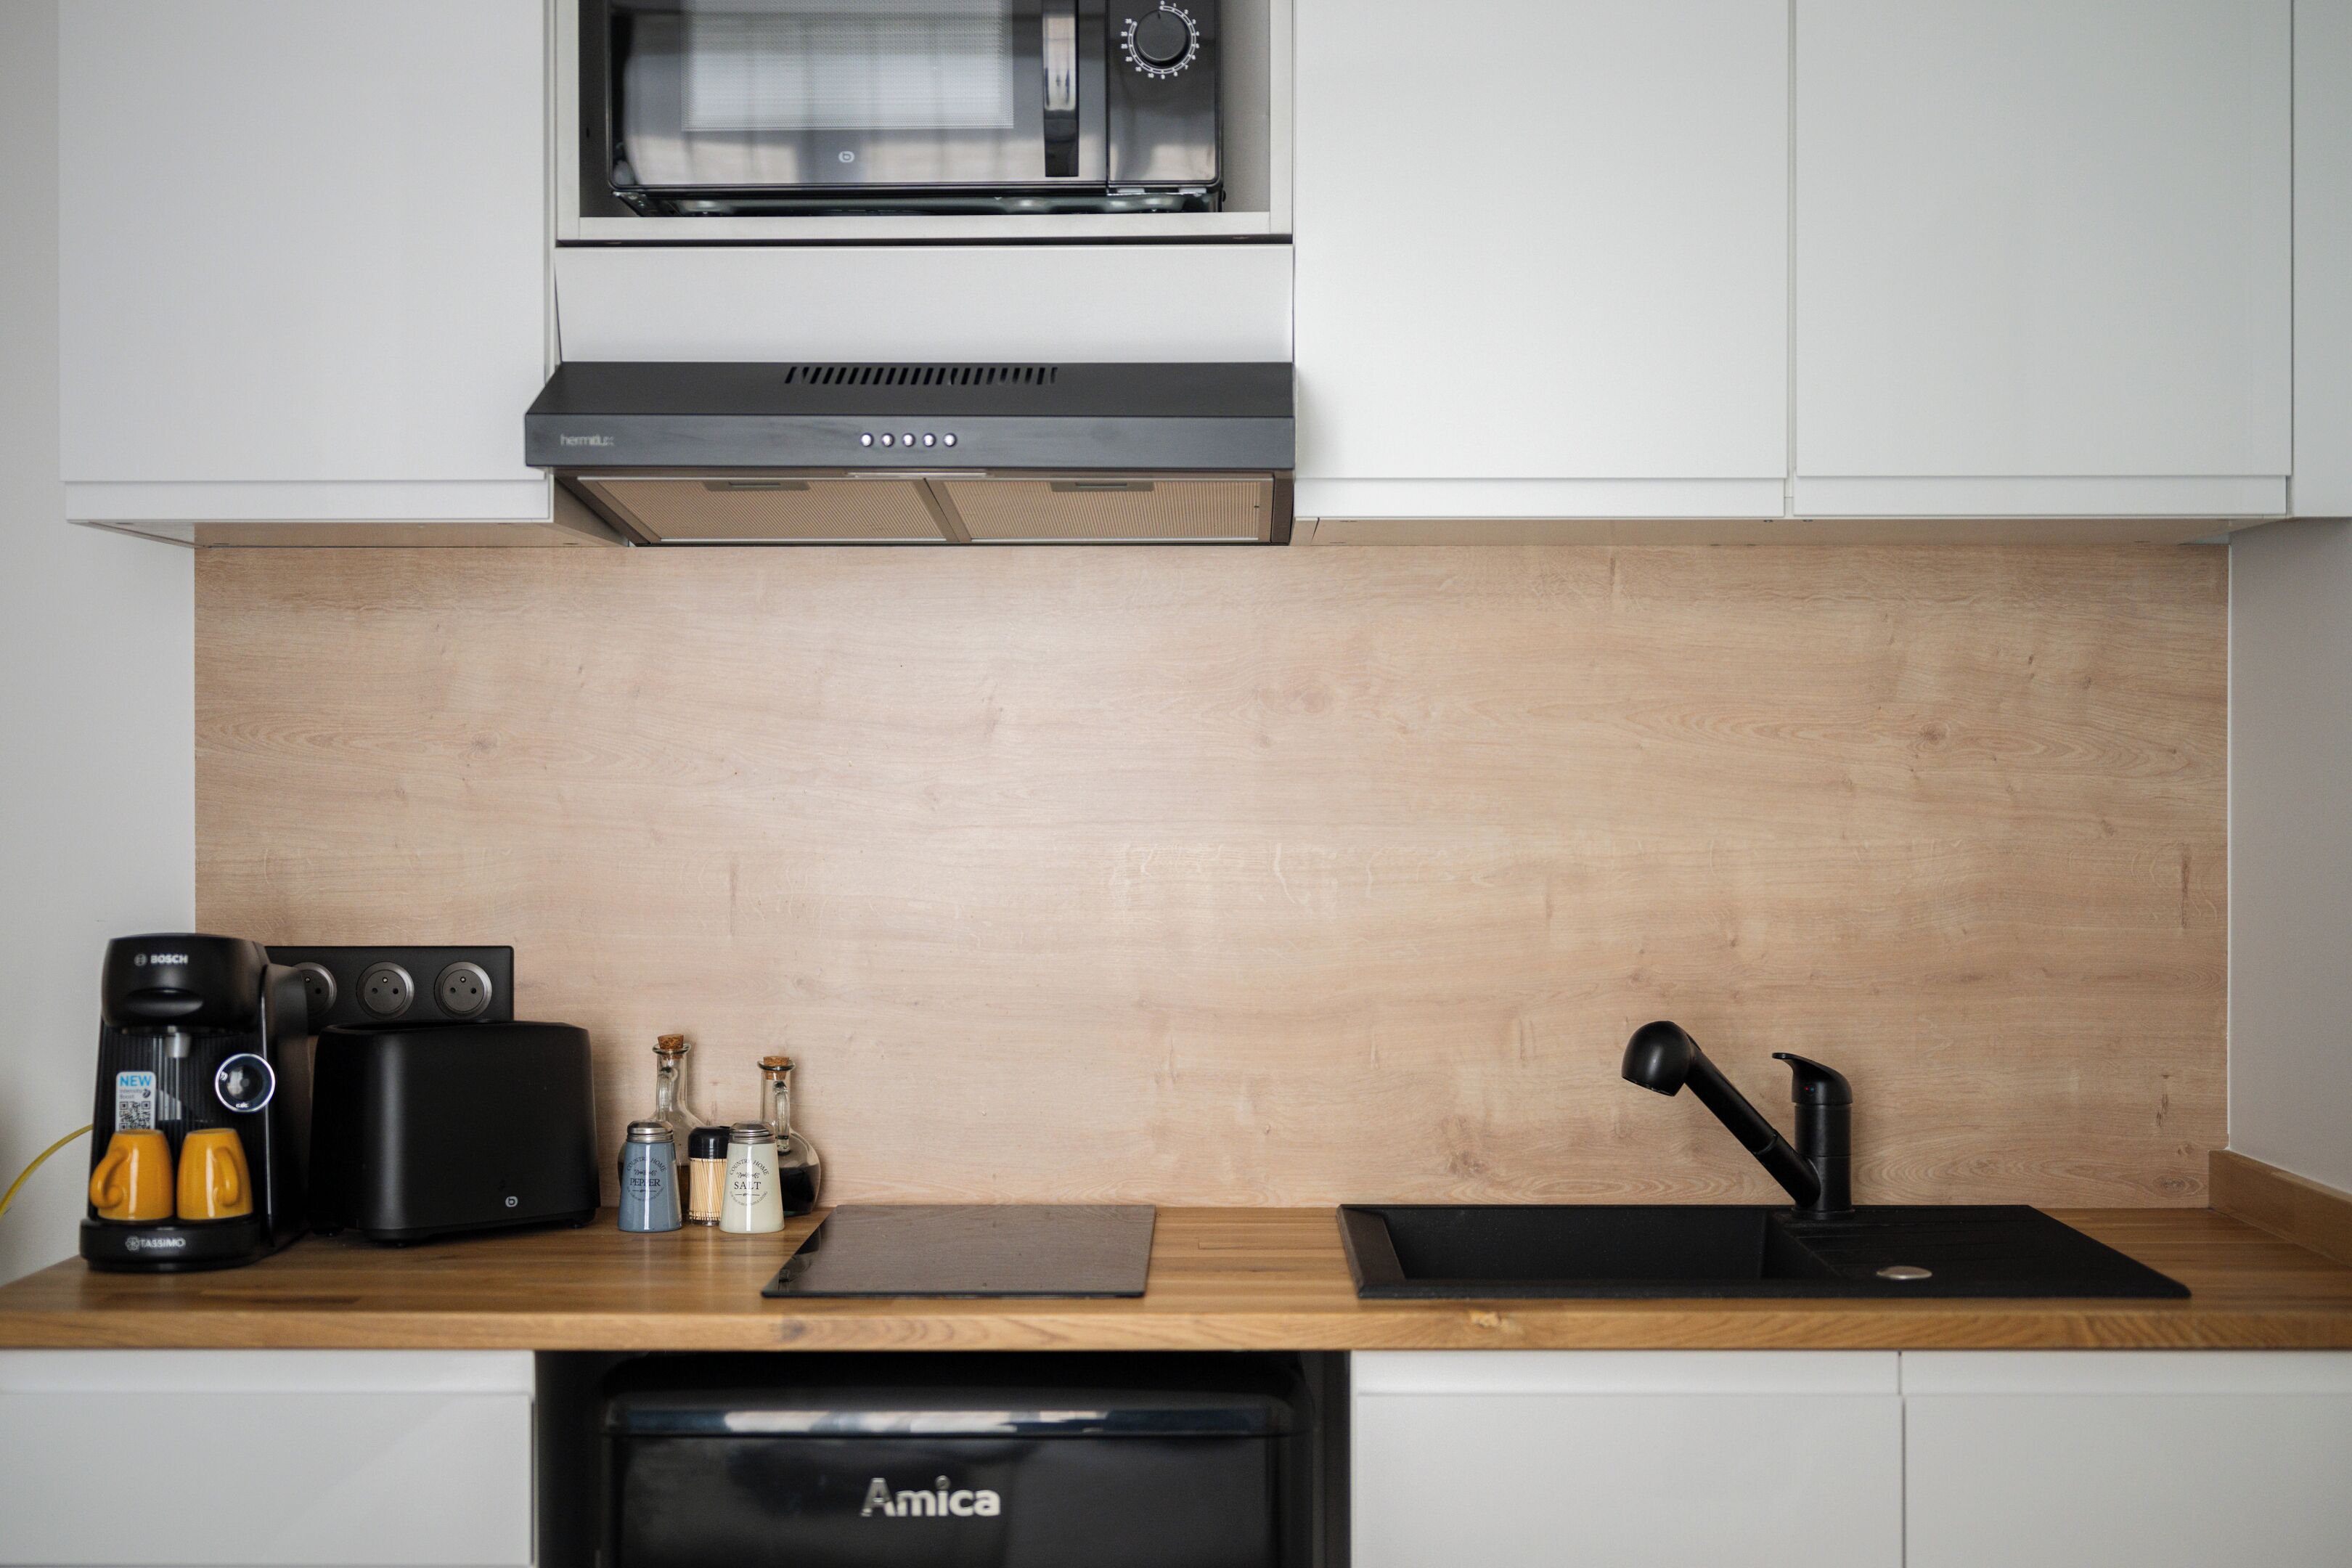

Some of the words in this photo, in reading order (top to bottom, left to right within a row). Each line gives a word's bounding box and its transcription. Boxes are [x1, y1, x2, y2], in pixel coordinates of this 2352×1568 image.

[150, 953, 188, 964] BOSCH
[119, 1075, 152, 1087] NEW
[626, 1156, 648, 1171] COUNTR
[650, 1157, 667, 1172] HOME
[730, 1158, 751, 1175] COUNTR
[753, 1159, 769, 1176] HOME
[734, 1181, 761, 1190] SALT
[140, 1237, 186, 1248] TASSIMO
[860, 1475, 1001, 1517] Amica
